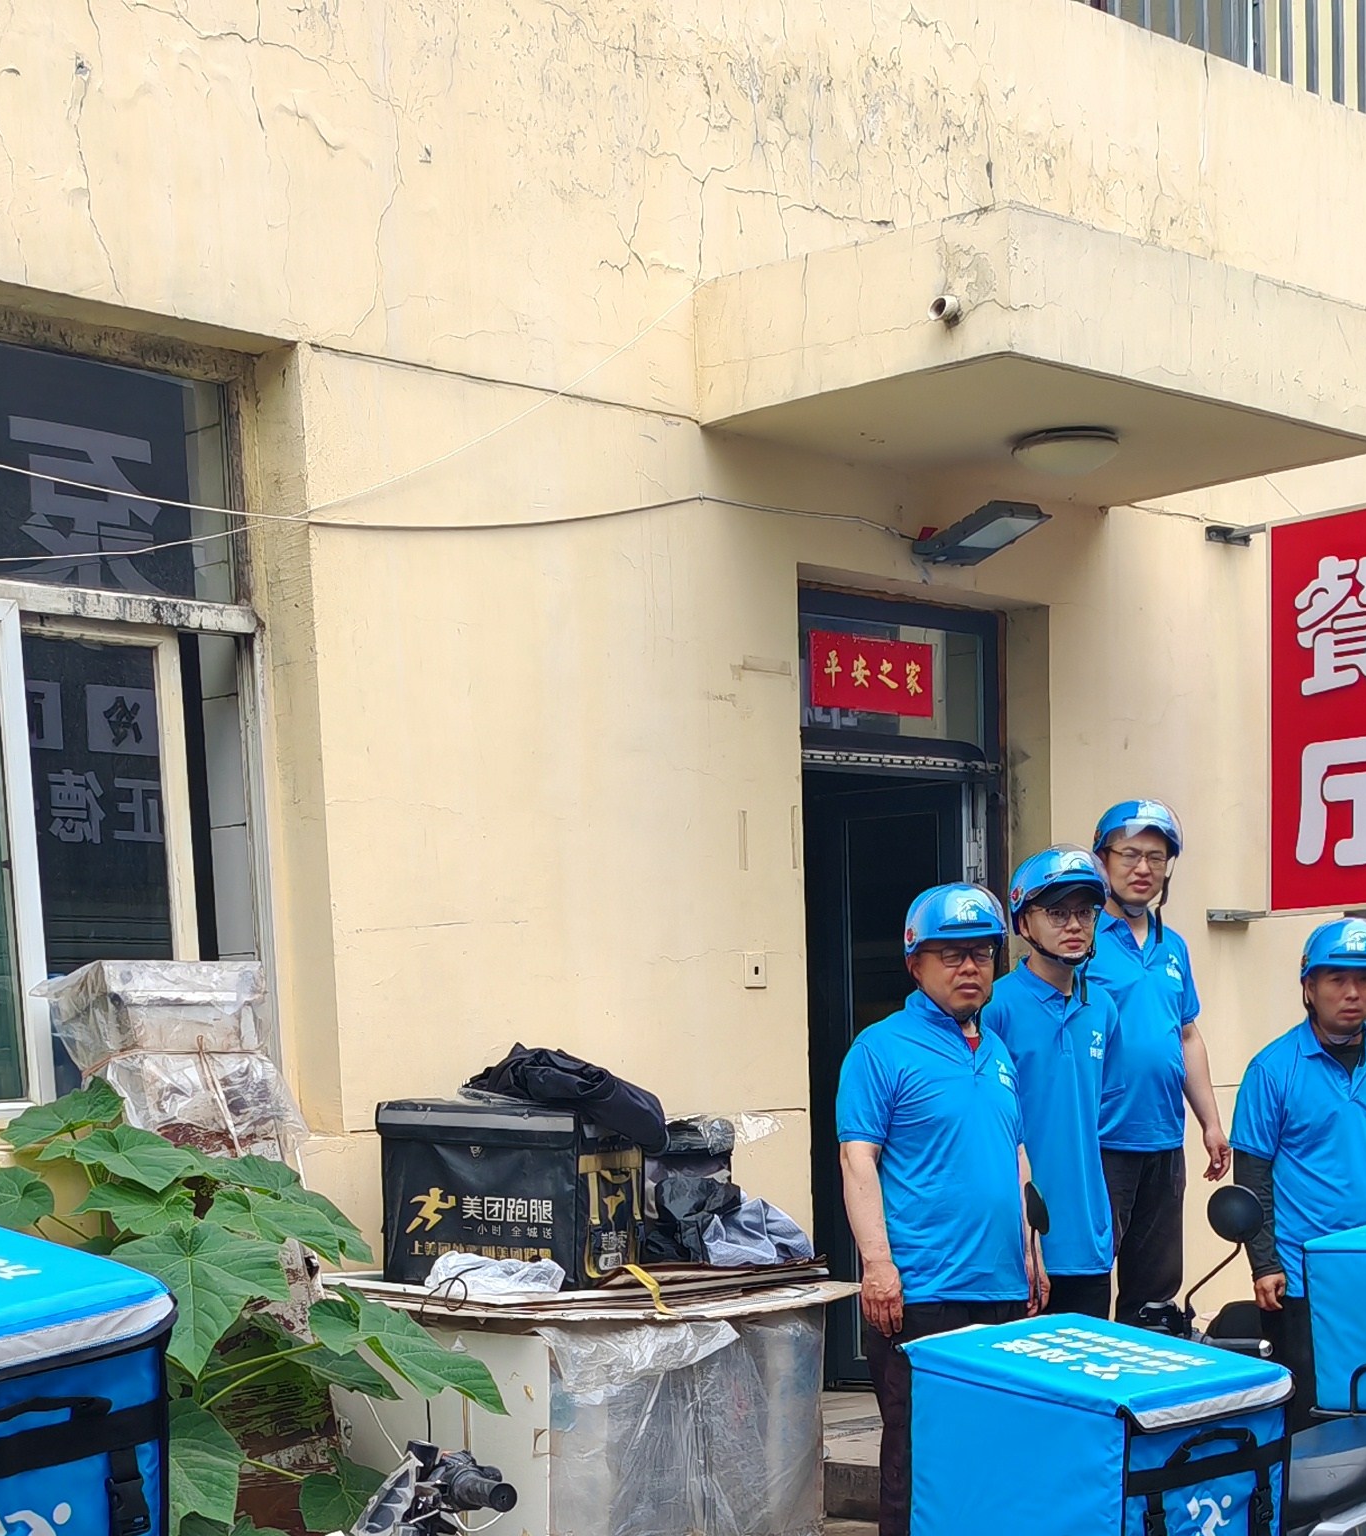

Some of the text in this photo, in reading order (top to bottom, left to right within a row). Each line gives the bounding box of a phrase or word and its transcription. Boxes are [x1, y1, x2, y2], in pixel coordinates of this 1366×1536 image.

[823, 649, 923, 696] 平安之家
[462, 1195, 554, 1225] 美团跑腿
